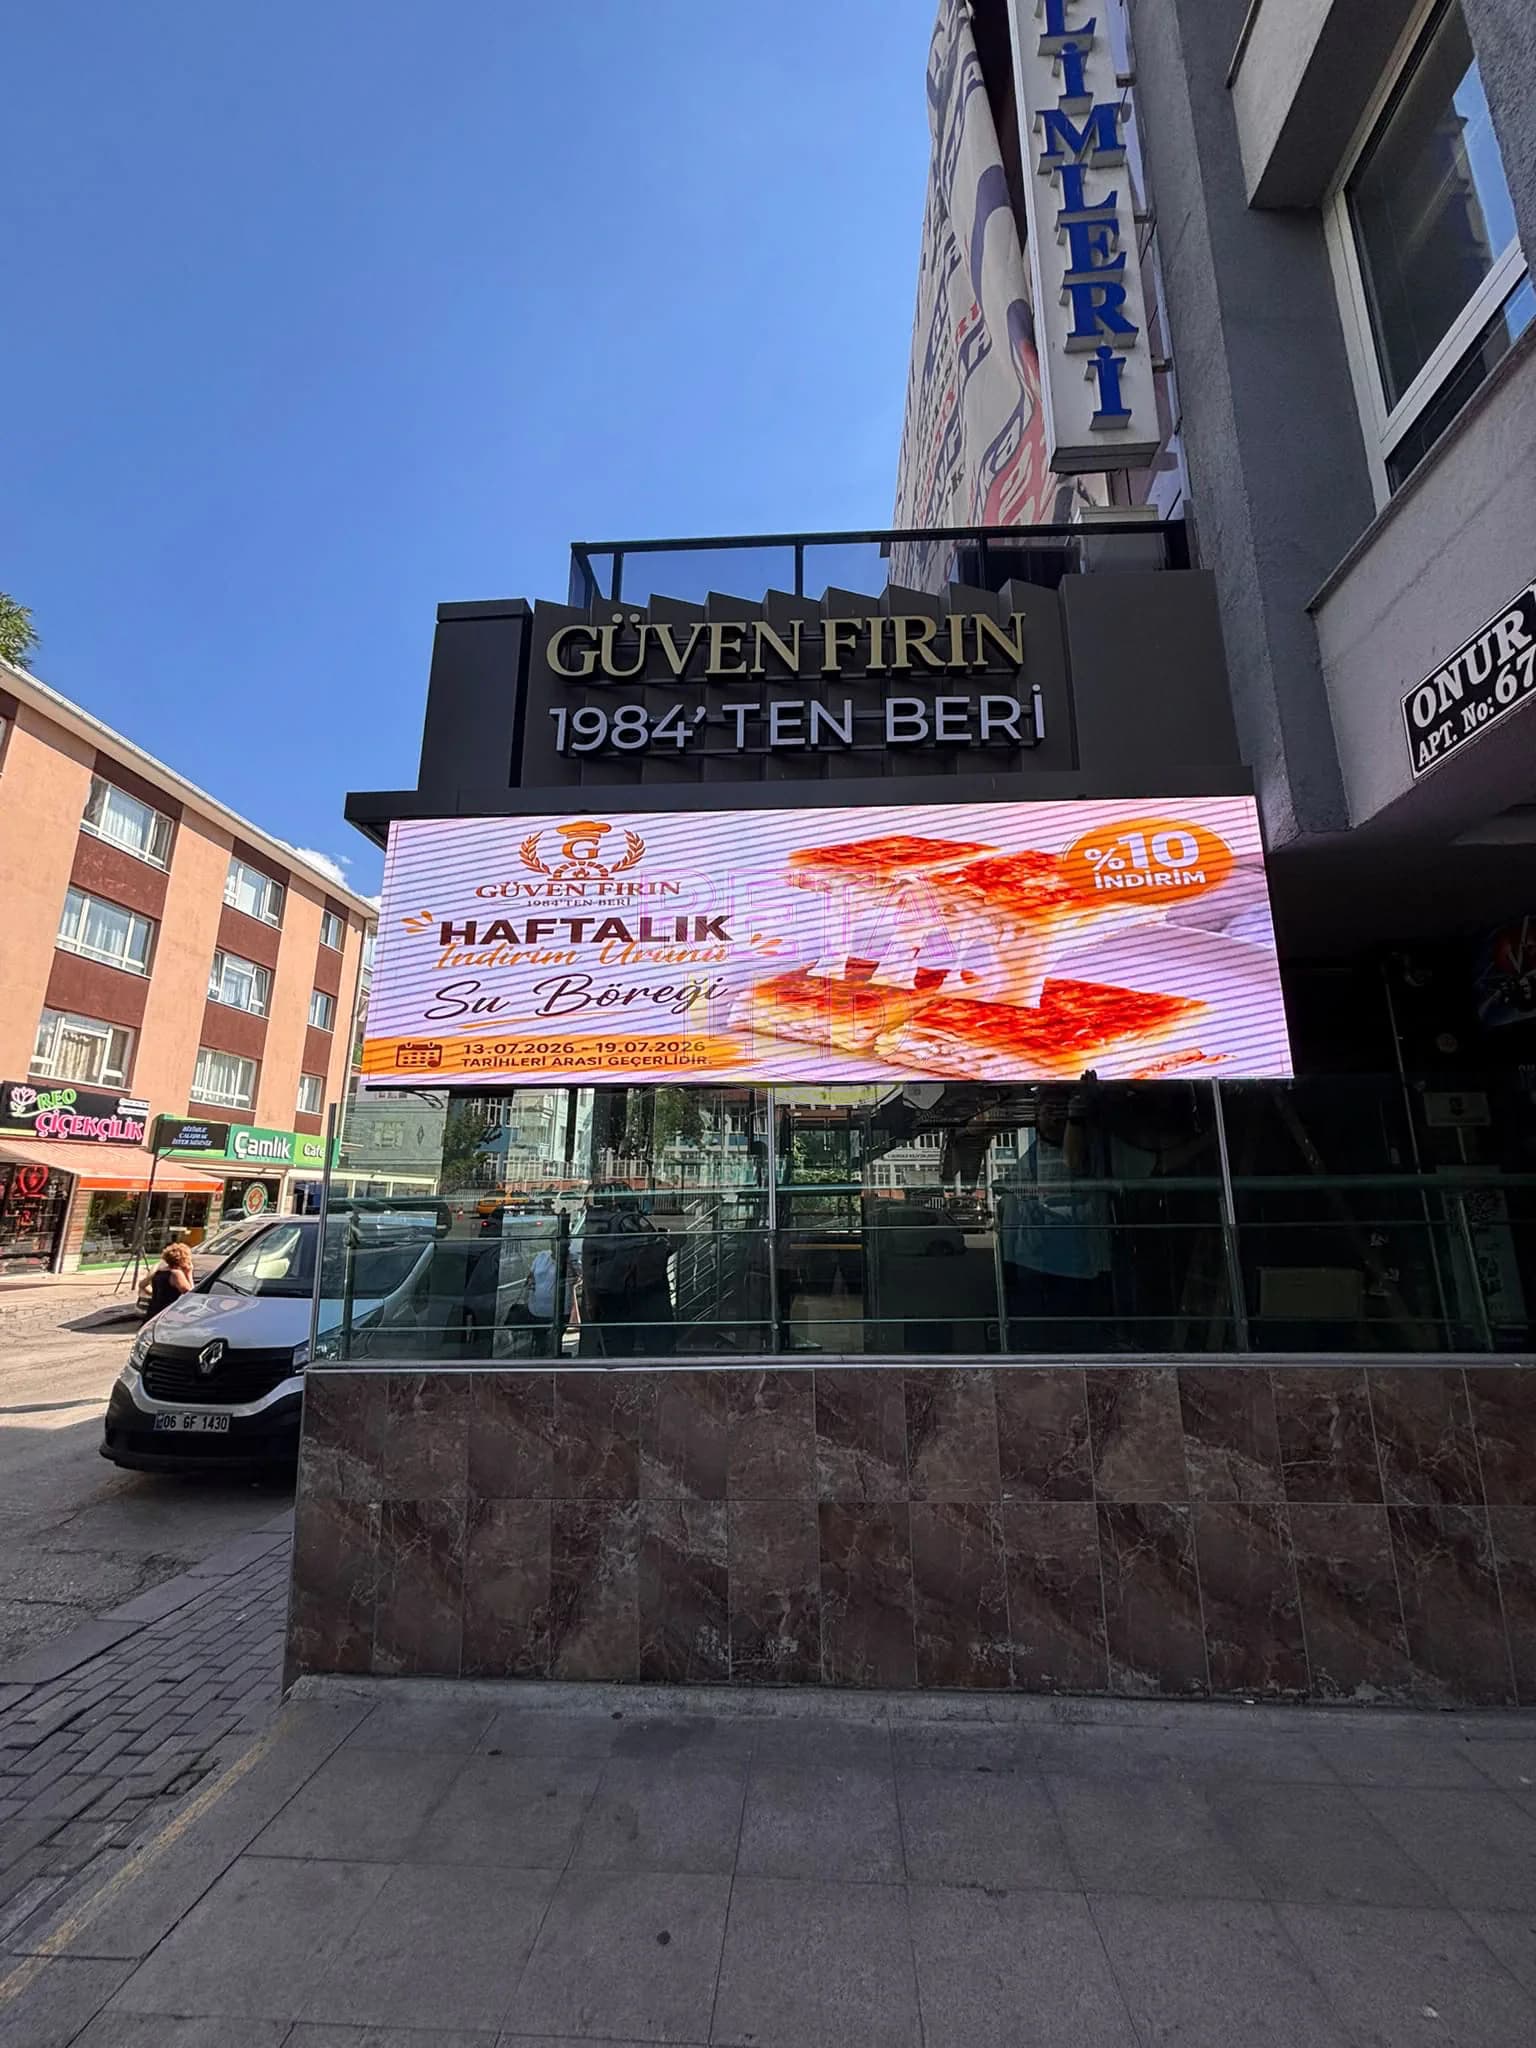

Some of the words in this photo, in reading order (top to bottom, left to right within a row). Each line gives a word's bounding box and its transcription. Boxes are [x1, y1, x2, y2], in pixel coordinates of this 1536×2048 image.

[546, 613, 804, 678] GÜVEN
[820, 612, 1026, 674] FIRIN
[1412, 610, 1533, 728] ONUR
[886, 684, 1045, 743] BERİ
[1418, 720, 1458, 767] APT.
[1084, 831, 1200, 871] %10
[475, 881, 587, 899] GÜVEN
[599, 881, 681, 897] FIRIN
[1094, 869, 1207, 889] İNDİRİM
[439, 914, 735, 946] HAFTALIK
[424, 979, 512, 1020] Su
[532, 974, 729, 1017] Böreği
[461, 1055, 546, 1067] TARİHLERİ
[551, 1056, 603, 1066] ARASI
[463, 1042, 575, 1055] 13.07.2026
[596, 1041, 706, 1054] 19.07.2026
[35, 1108, 145, 1142] ÇİÇEKÇİLİK
[234, 1131, 292, 1160] Çamlık
[164, 1415, 177, 1429] 06
[183, 1415, 197, 1430] GF
[202, 1415, 228, 1430] 1430
